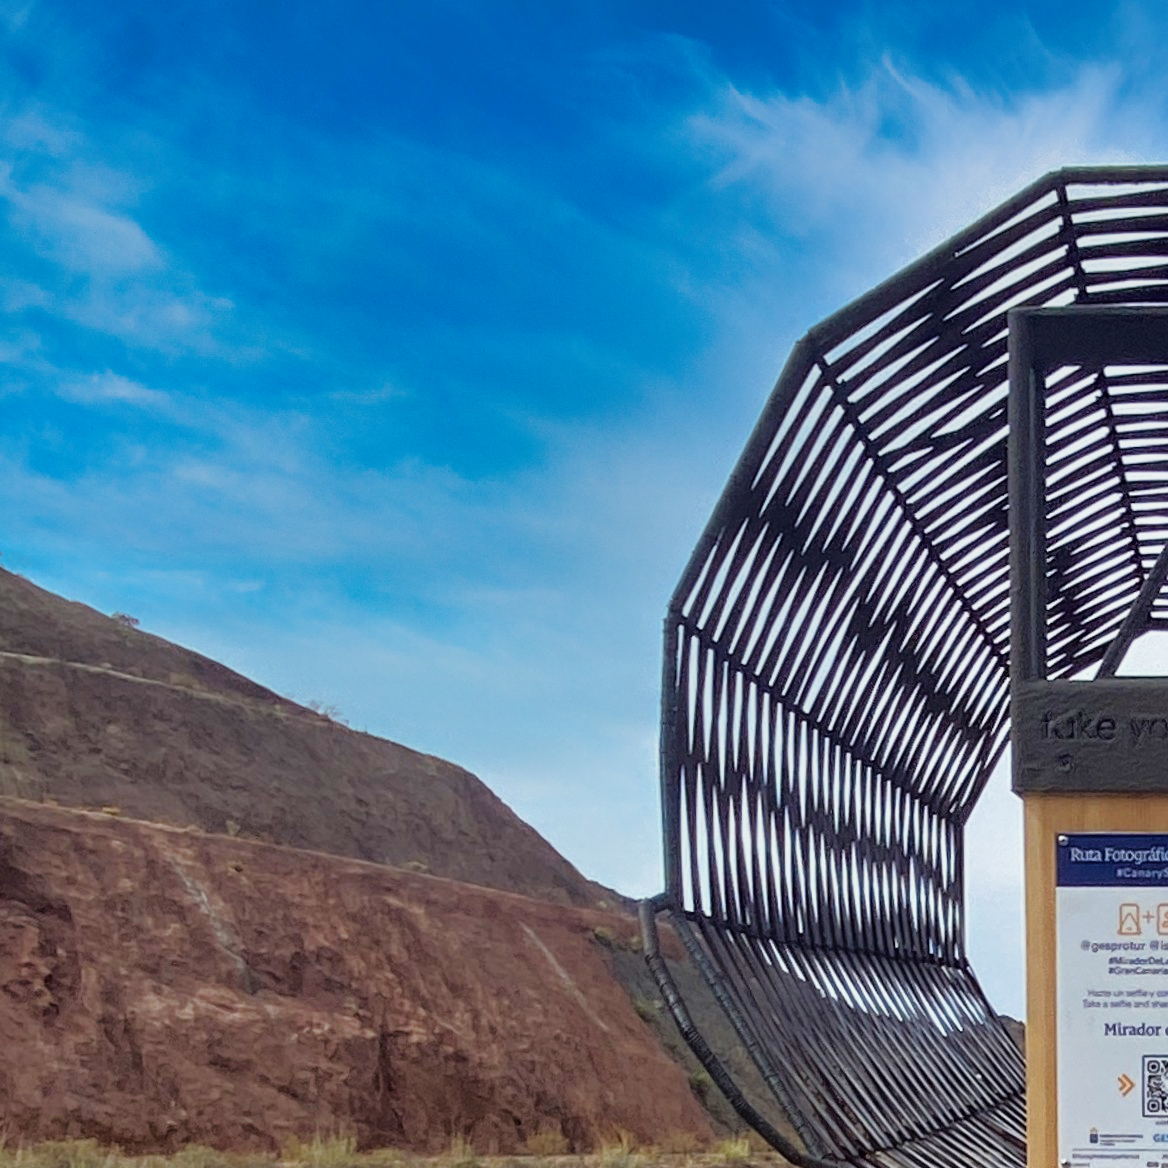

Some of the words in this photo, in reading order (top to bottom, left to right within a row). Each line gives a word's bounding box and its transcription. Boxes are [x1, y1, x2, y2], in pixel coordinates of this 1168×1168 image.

[1041, 711, 1117, 740] take
[1070, 847, 1102, 861] Ruta
[1080, 940, 1146, 953] @gesprotur
[1104, 1022, 1162, 1037] Mirador
